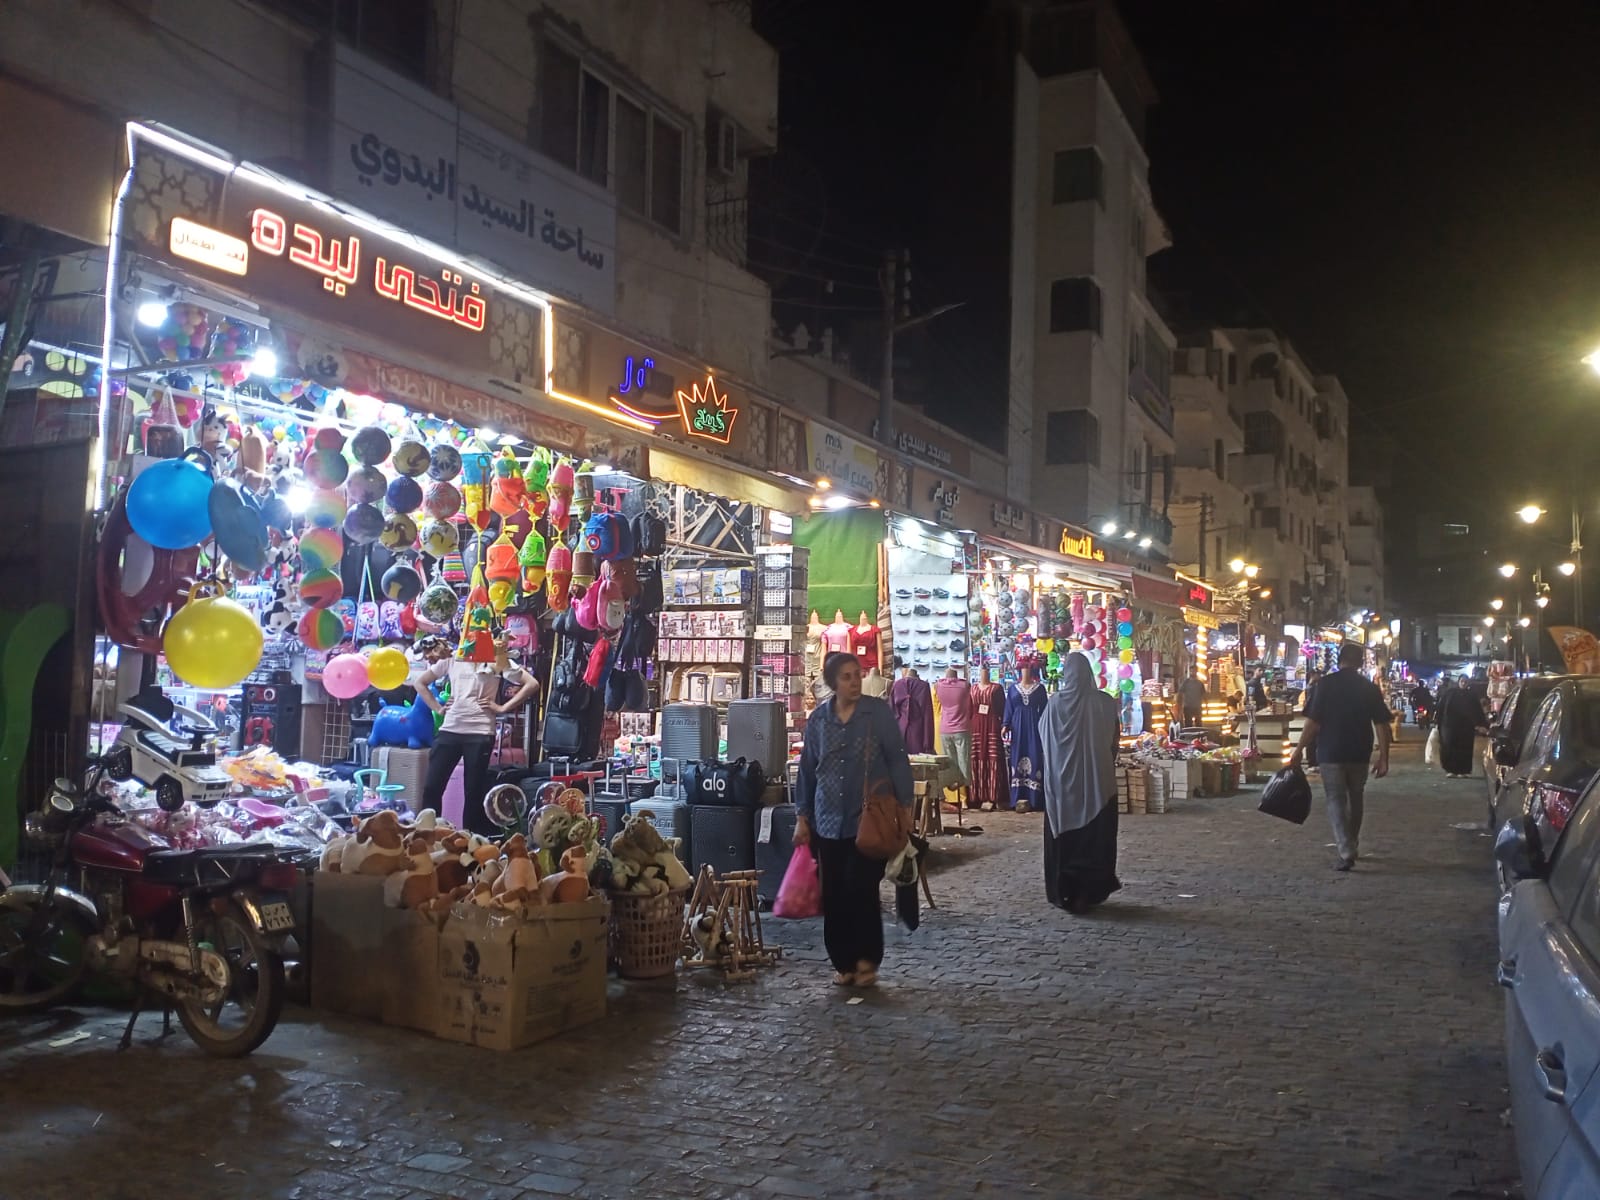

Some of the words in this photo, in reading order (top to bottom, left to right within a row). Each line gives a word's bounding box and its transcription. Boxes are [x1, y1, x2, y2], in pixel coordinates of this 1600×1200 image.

[350, 130, 456, 203] البدوي
[462, 183, 535, 238] السيد
[541, 208, 604, 270] ساحة
[251, 207, 361, 297] ليده
[702, 772, 726, 792] alo
